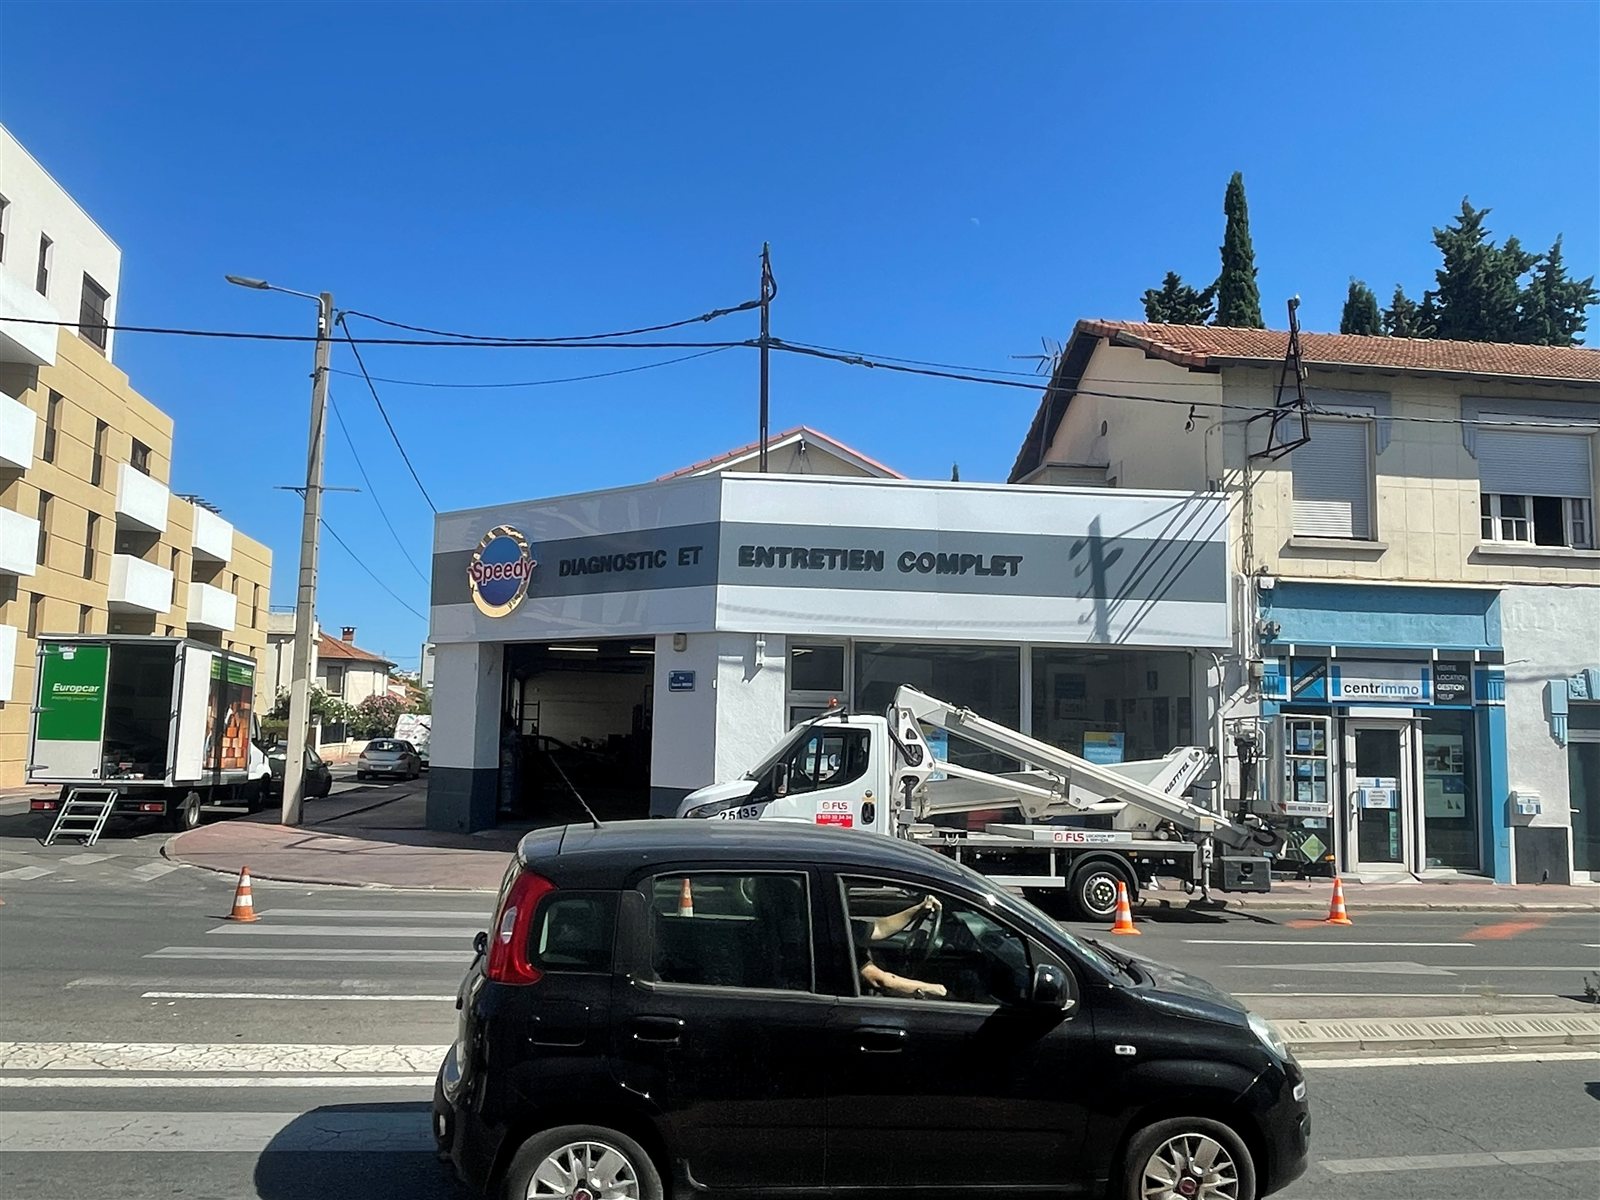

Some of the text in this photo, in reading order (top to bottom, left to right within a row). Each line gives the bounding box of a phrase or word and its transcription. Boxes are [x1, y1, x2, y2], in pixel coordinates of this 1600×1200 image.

[559, 546, 703, 577] DIAGNOSTIC ET
[738, 545, 1024, 577] ENTRETIEN COMPLET
[467, 556, 537, 587] Speedy
[1436, 664, 1457, 672] VENTE
[1436, 674, 1469, 682] LOCATION
[52, 683, 100, 694] Europcar
[1344, 682, 1419, 695] centrimmo
[1436, 683, 1465, 691] GESTION
[1436, 693, 1455, 701] NEUF
[831, 801, 848, 810] FLS
[1065, 832, 1085, 842] FLS
[1205, 850, 1211, 859] 2
